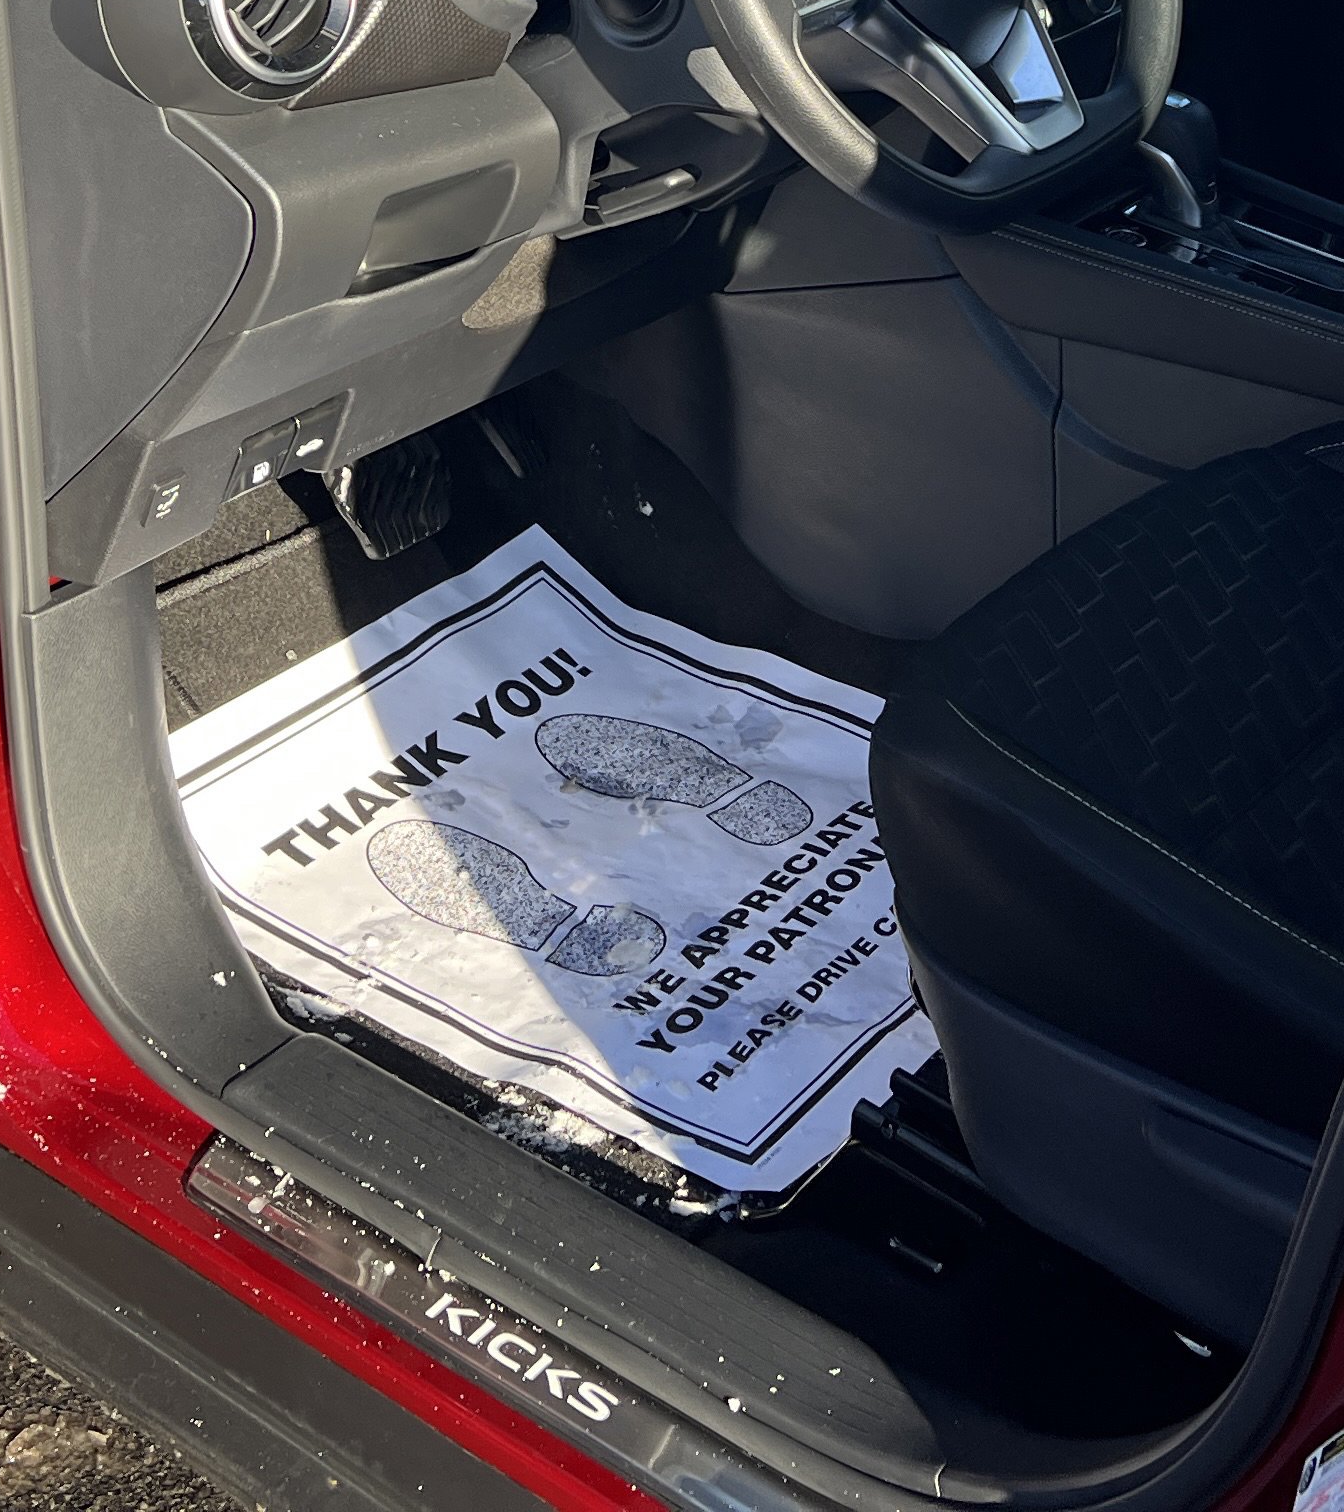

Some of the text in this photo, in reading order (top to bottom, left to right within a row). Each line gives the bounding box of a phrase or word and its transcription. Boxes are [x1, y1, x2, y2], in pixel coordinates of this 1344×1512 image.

[260, 647, 593, 867] THANK YOU!
[612, 800, 875, 1016] WE APPRECIATE
[635, 835, 886, 1054] YOUR PATRON
[696, 999, 805, 1093] PLEASE
[796, 935, 880, 1004] DRIVE
[424, 1292, 619, 1423] KICKS
